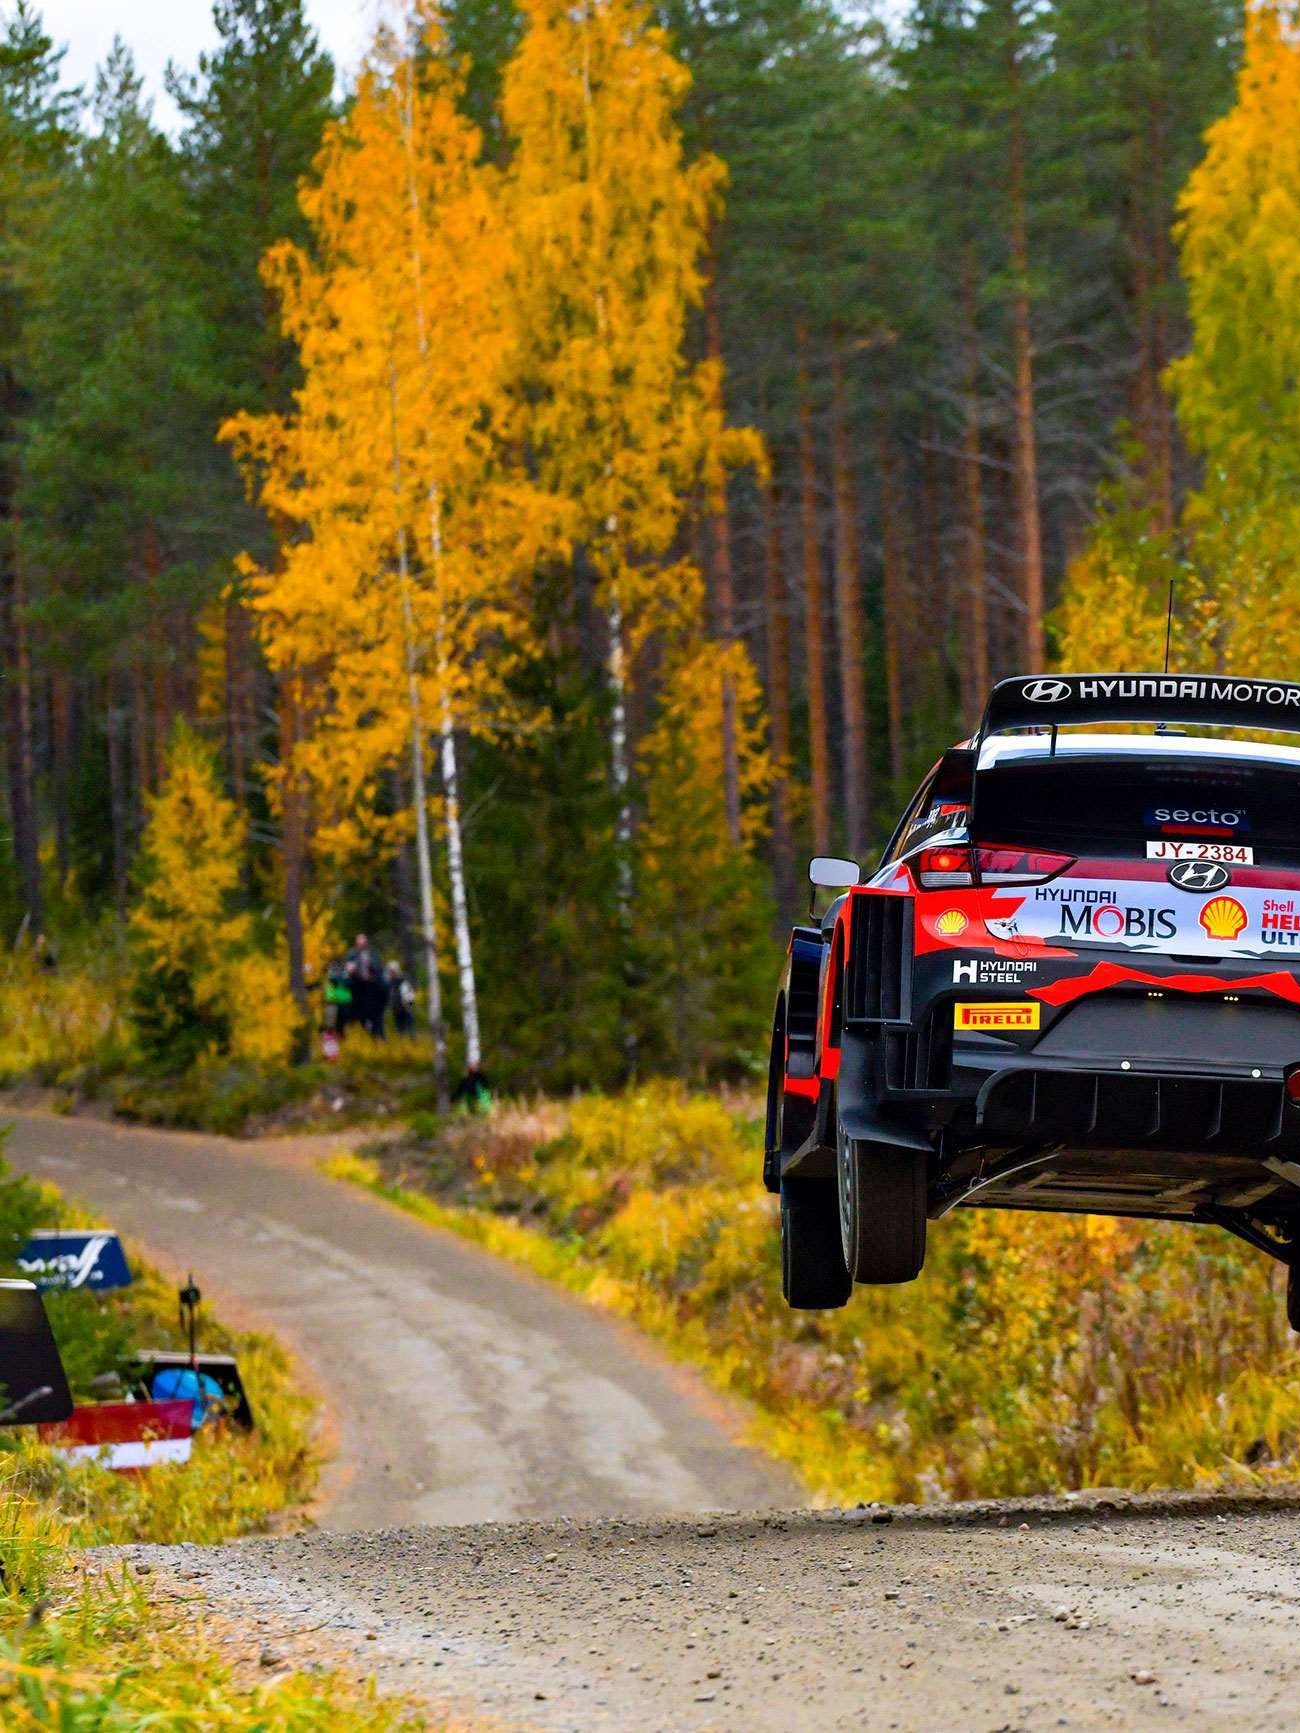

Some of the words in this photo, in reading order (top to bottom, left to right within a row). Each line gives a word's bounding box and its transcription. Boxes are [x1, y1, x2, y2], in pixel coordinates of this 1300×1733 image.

[1079, 680, 1207, 699] HYUNDAI
[1154, 808, 1240, 826] secto
[1154, 842, 1248, 863] JY-2384
[1035, 887, 1117, 905] HYUNDAI
[1263, 899, 1294, 912] Shell
[1059, 904, 1177, 939] MOBIS
[980, 961, 1037, 972] HYUNDAI
[979, 973, 1021, 983] STEEL
[962, 1007, 1032, 1025] PIRELLI
